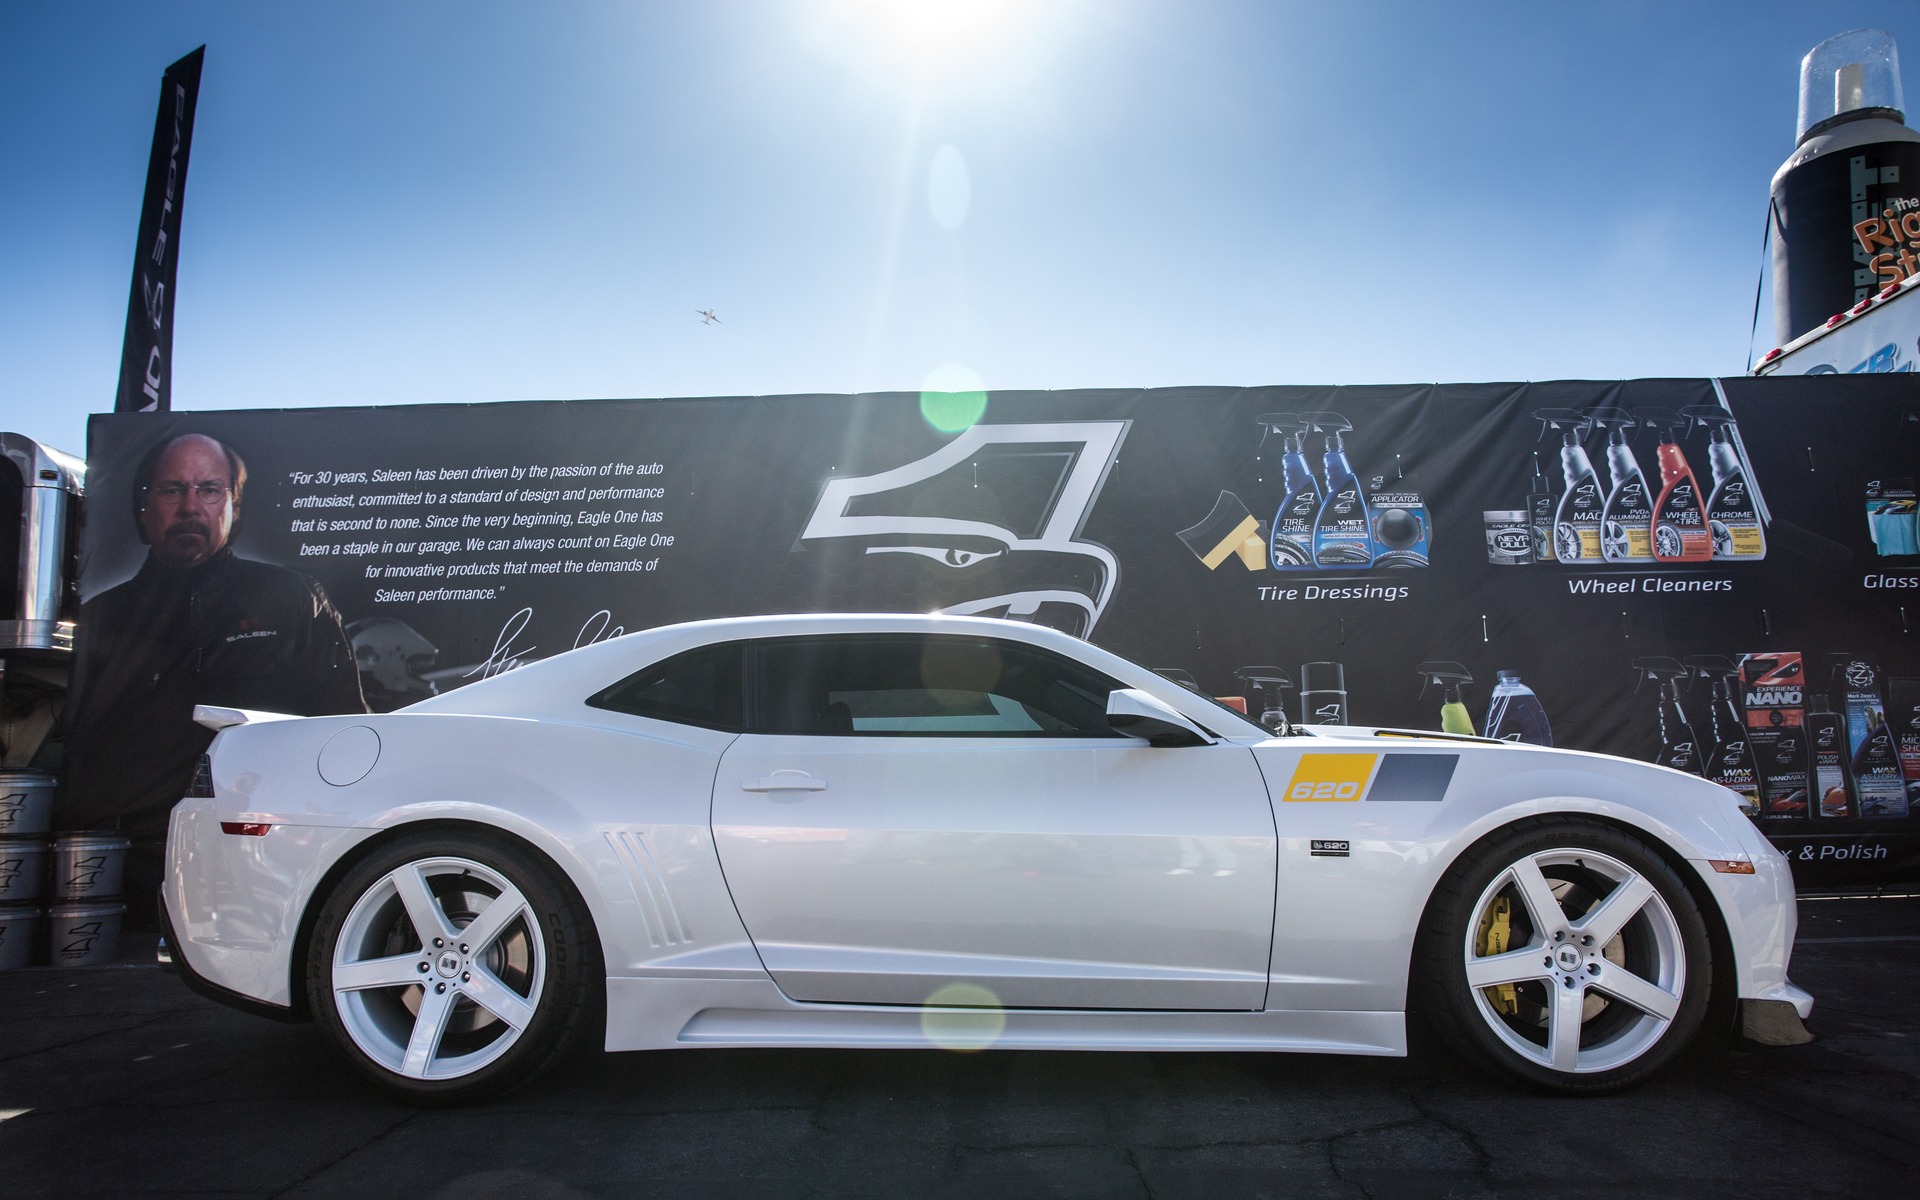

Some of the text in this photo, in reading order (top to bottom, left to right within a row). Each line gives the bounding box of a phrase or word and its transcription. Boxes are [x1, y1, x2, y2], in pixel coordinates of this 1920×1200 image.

[1895, 196, 1920, 212] the
[1853, 209, 1920, 254] Rig
[1869, 248, 1920, 290] St
[139, 345, 161, 412] ON
[315, 471, 332, 484] 30
[332, 472, 368, 486] years,
[371, 469, 412, 482] Saleen
[414, 468, 437, 481] has
[438, 467, 469, 480] been
[471, 466, 508, 479] driven
[511, 465, 527, 481] by
[529, 465, 548, 478] the
[550, 464, 597, 480] passion
[599, 463, 613, 476] of
[615, 462, 634, 475] the
[636, 462, 664, 475] auto
[292, 486, 665, 508] enthusiast, committed to a standard of design and performance
[291, 510, 663, 532] that is second to none. Since the very beginning, Eagle One has
[1665, 511, 1699, 519] WHEEL
[1711, 511, 1753, 519] CHROME
[300, 533, 674, 557] been a staple in our garage. We can always count on Eagle One
[365, 558, 660, 579] for innovative products that meet the demands of
[1568, 577, 1733, 594] Wheel Cleaners
[1864, 574, 1919, 589] Glass
[374, 589, 415, 602] Saleen
[1257, 585, 1409, 602] Tire Dressings
[226, 630, 277, 643] SALEEN
[1756, 685, 1802, 693] EXPERIENCE
[1745, 691, 1803, 706] NANO
[1901, 736, 1920, 745] MIC
[1722, 768, 1752, 777] WAX
[1767, 774, 1807, 782] NANOWAX
[1291, 781, 1359, 799] 620
[1323, 841, 1348, 850] 620
[1798, 844, 1815, 861] &
[1819, 843, 1887, 859] Polish
